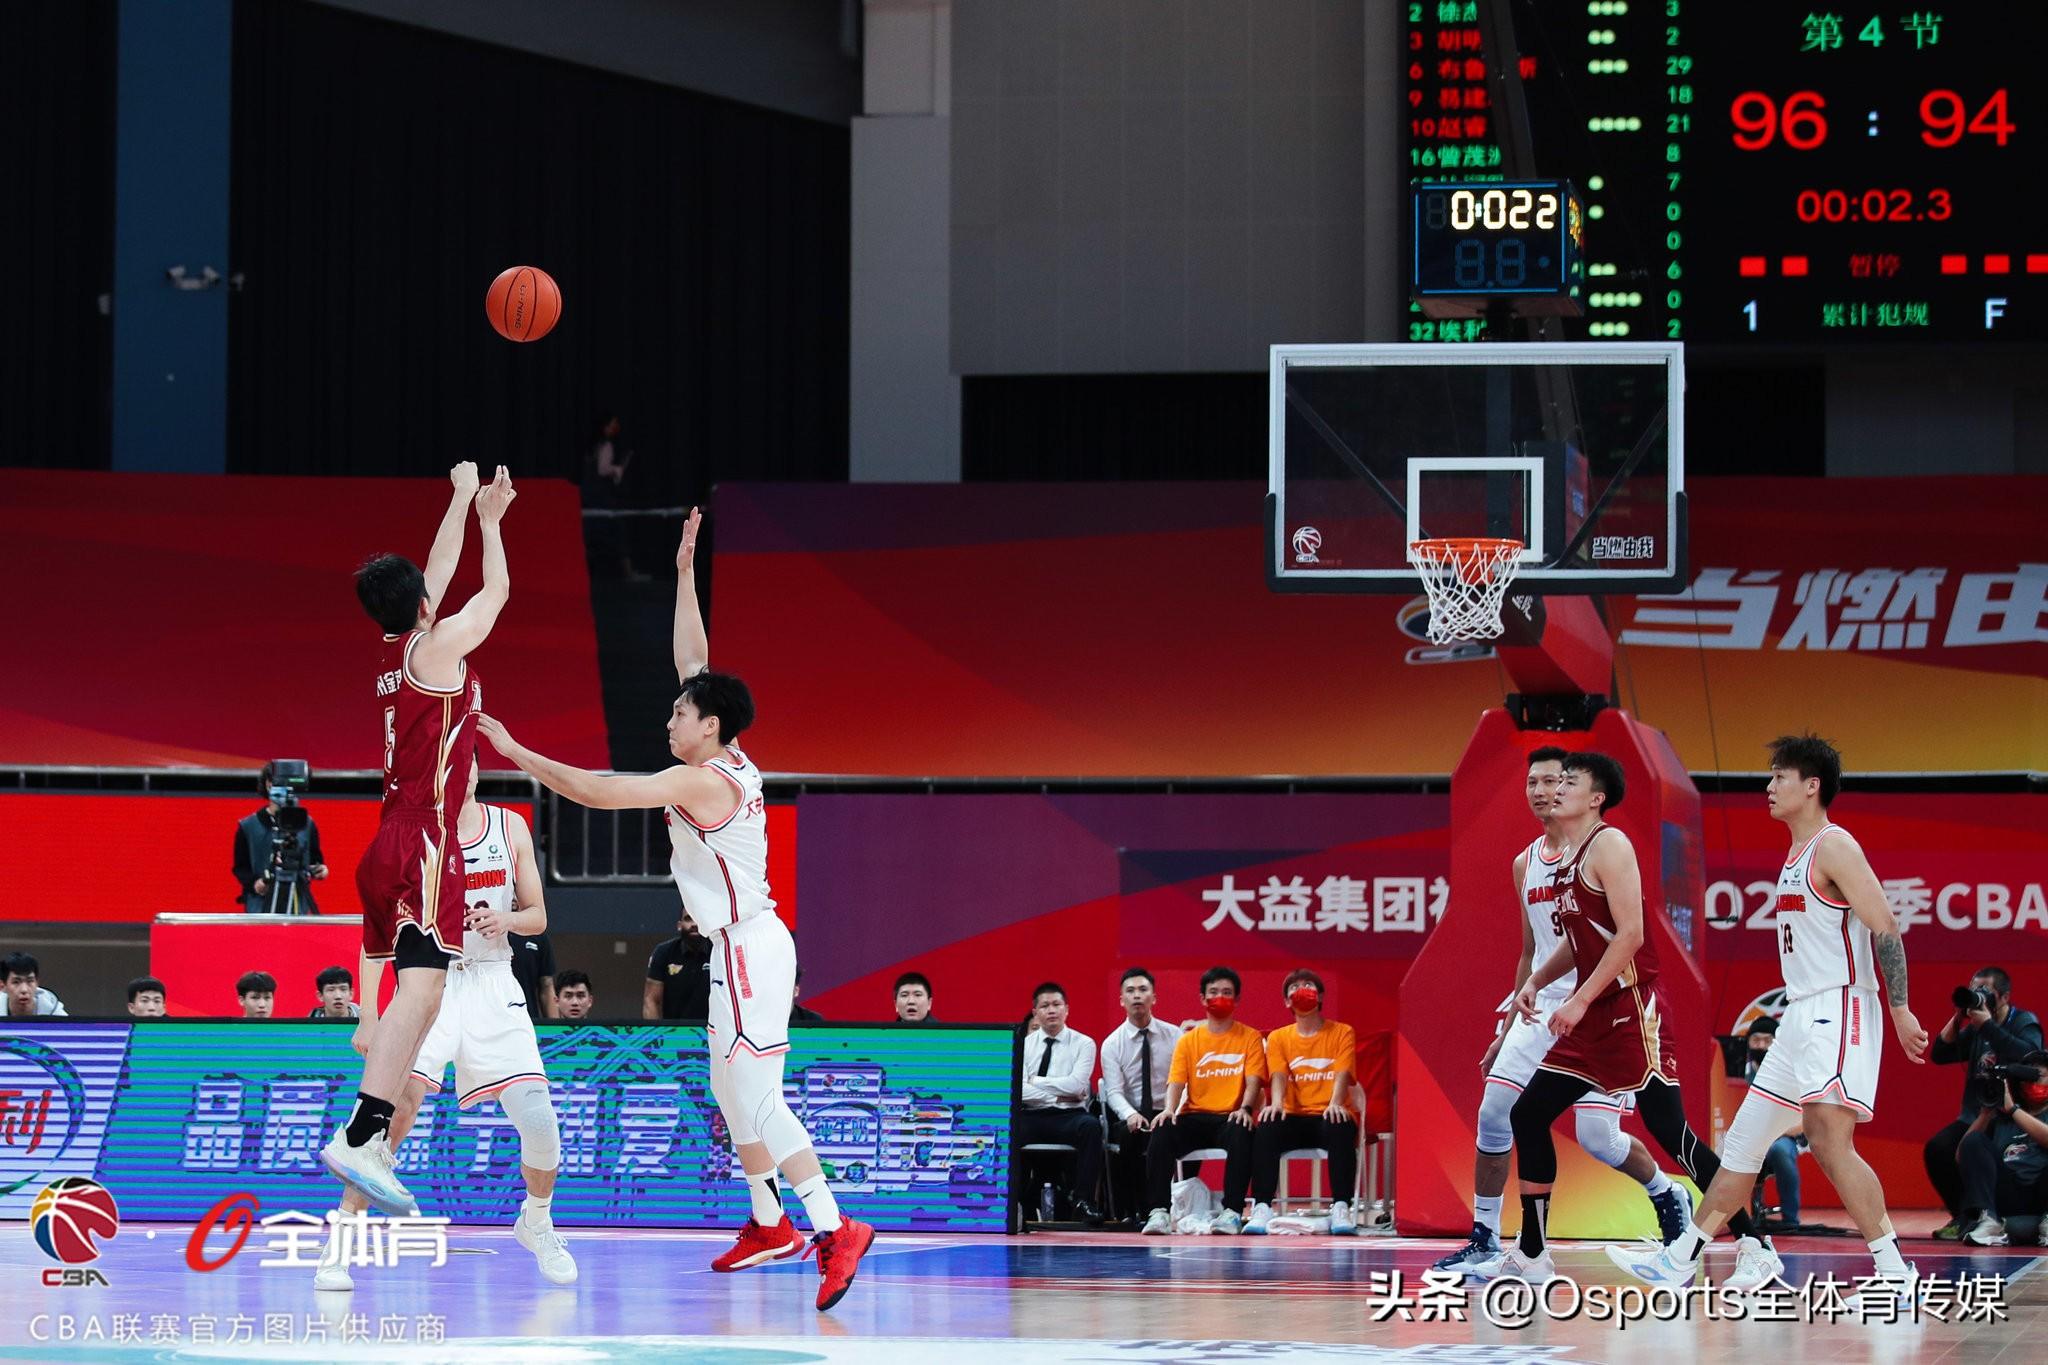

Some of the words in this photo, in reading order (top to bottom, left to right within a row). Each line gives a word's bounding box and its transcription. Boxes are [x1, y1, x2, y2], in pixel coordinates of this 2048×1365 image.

[1409, 3, 1422, 22] 2
[1667, 0, 1680, 16] 3
[1409, 31, 1423, 49] 3
[1667, 27, 1680, 45] 2
[1801, 12, 1943, 51] 第4节
[1666, 56, 1693, 75] 29
[1409, 90, 1422, 108] 9
[1668, 85, 1693, 104] 18
[1411, 118, 1435, 137] 10
[1667, 114, 1691, 133] 21
[1731, 91, 1828, 150] 96
[1919, 88, 2016, 147] 94
[1411, 147, 1436, 166] 16
[1667, 144, 1681, 162] 8
[1667, 172, 1681, 191] 7
[1666, 201, 1681, 221] 0
[1796, 189, 1951, 222] 00:02.3
[1666, 230, 1681, 250] 0
[1666, 260, 1682, 280] 6
[1666, 289, 1682, 309] 0
[1743, 300, 1757, 331] 1
[1822, 302, 1929, 327] 累计犯规
[1985, 298, 2007, 329] F
[1409, 321, 1435, 341] 32
[1667, 318, 1681, 338] 2
[1592, 536, 1653, 559] 当燃由我
[1618, 563, 2048, 650] 当燃由
[1551, 911, 1564, 937] 9
[814, 1117, 869, 1144] 纯牛奶
